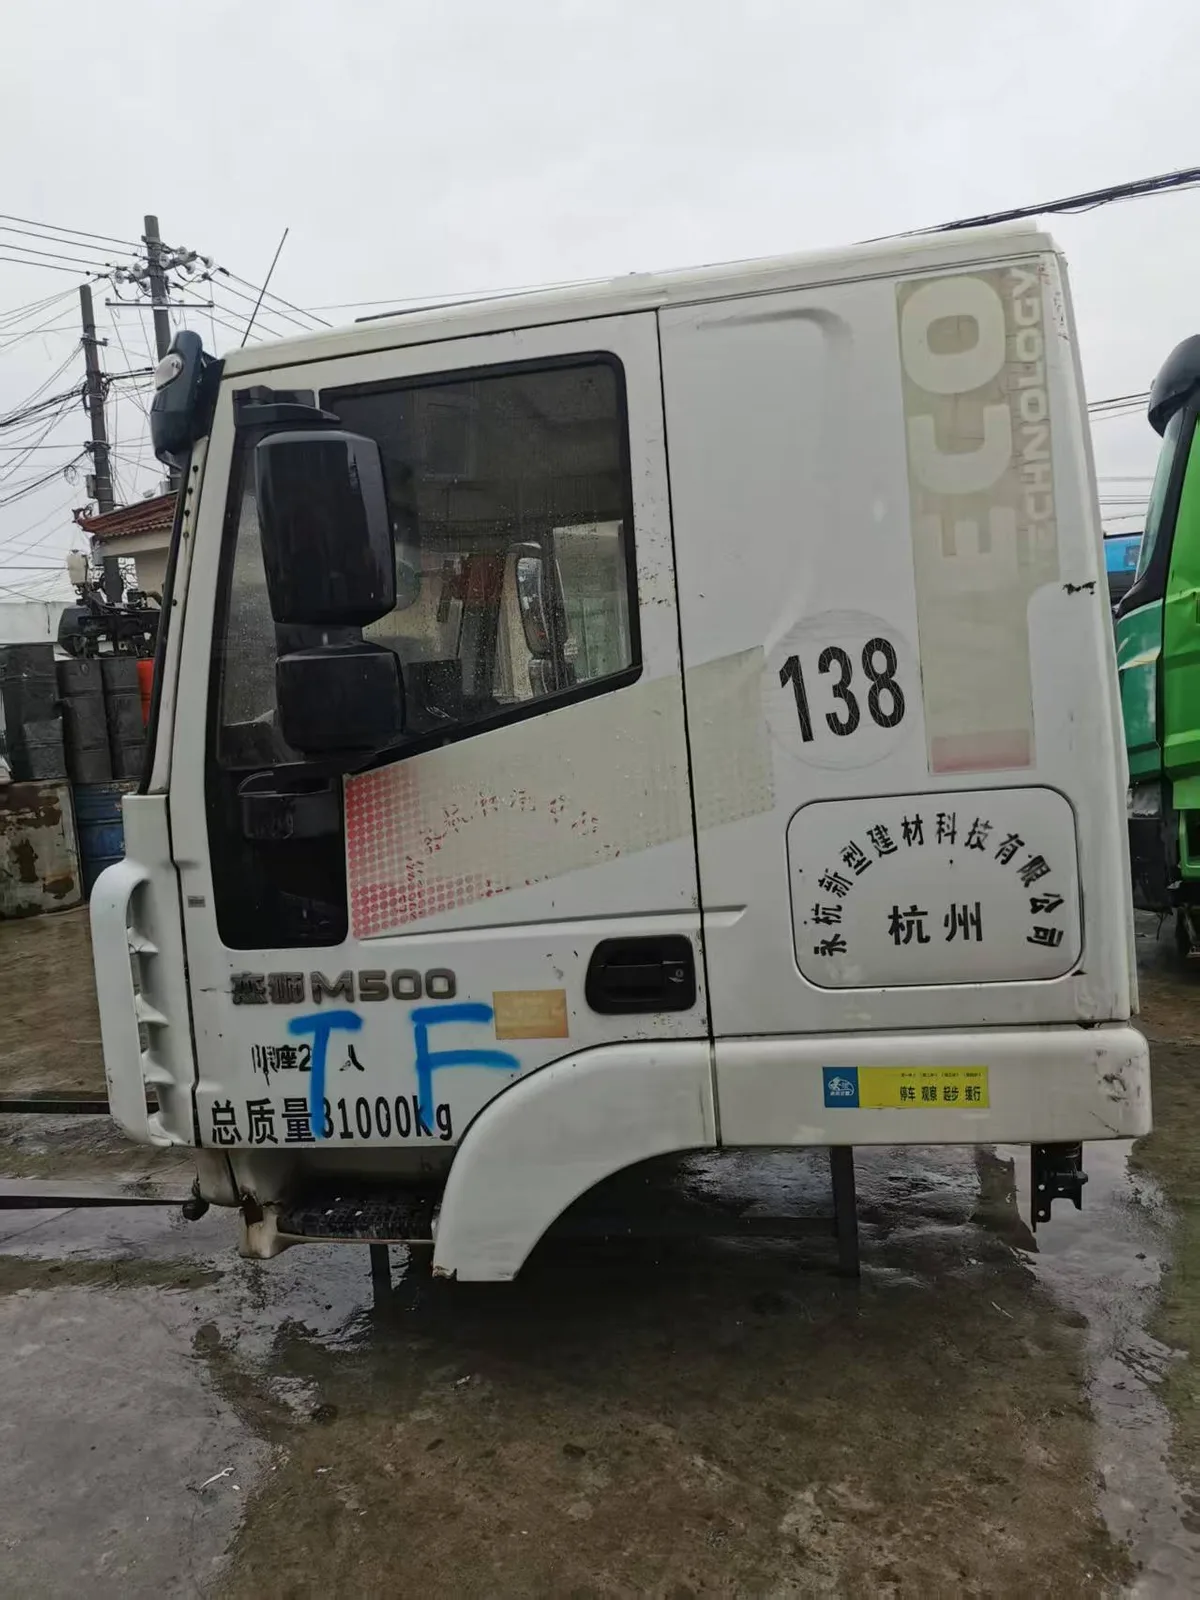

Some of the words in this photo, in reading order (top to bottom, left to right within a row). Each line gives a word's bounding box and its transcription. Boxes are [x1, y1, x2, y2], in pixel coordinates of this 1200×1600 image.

[779, 637, 905, 743] 138
[887, 902, 983, 946] 杭州
[288, 1009, 364, 1139] T
[410, 1003, 521, 1135] F
